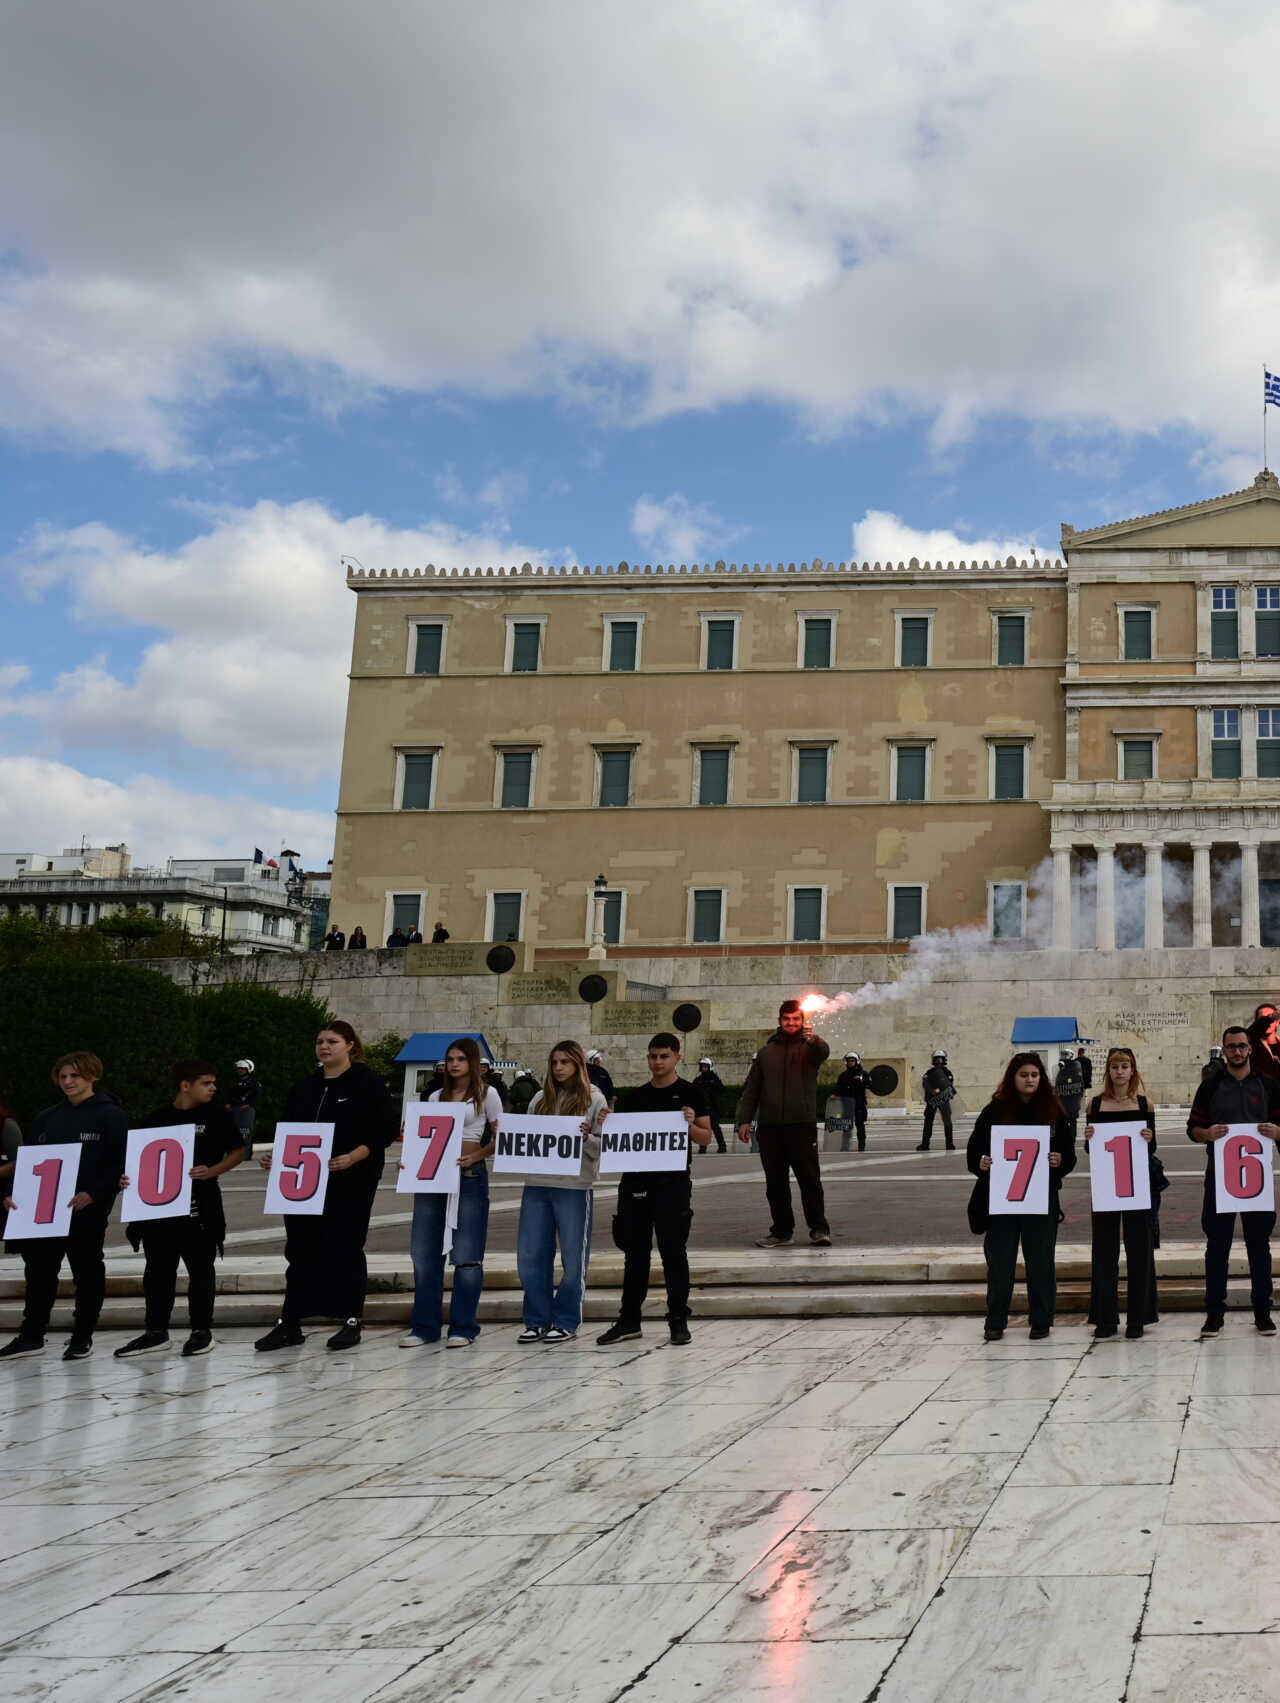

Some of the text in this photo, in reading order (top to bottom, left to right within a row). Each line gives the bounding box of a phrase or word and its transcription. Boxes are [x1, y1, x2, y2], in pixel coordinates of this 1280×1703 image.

[137, 1138, 184, 1206] 0
[279, 1134, 322, 1201] 5
[416, 1115, 455, 1180] 7
[497, 1131, 581, 1160] ΝΕΚΡΟΙ
[601, 1131, 687, 1153] ΜΑΘΗΤΕΣ
[1003, 1138, 1040, 1202] 7
[1104, 1135, 1134, 1198] 1
[1223, 1135, 1264, 1199] 6
[32, 1158, 63, 1224] 1
